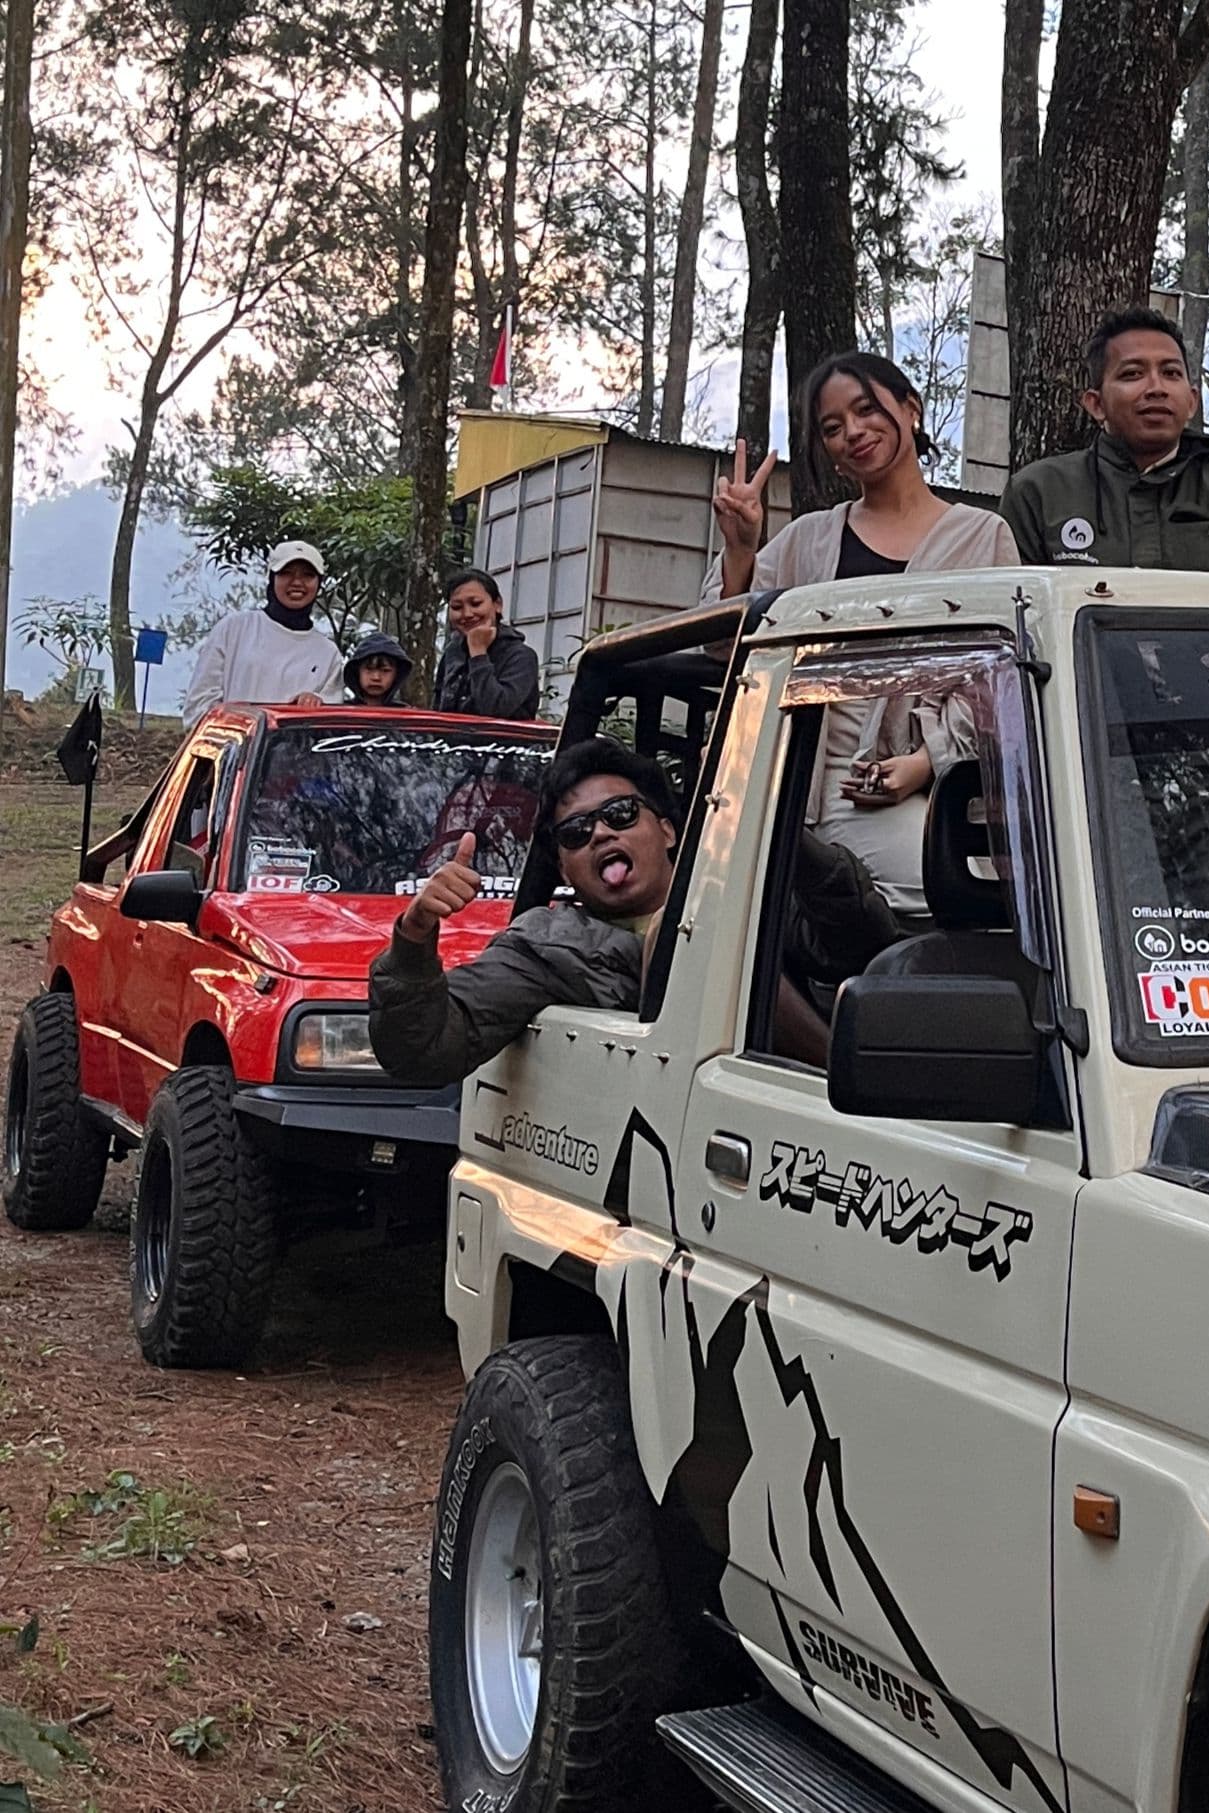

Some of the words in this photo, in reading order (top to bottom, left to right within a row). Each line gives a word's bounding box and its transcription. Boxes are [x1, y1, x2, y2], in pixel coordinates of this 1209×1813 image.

[1132, 907, 1172, 918] Official
[1153, 962, 1191, 972] ASIAN
[503, 1111, 600, 1176] adventure
[760, 1140, 1033, 1283] スピードハンターズ
[799, 1620, 940, 1740] SURVIVE
